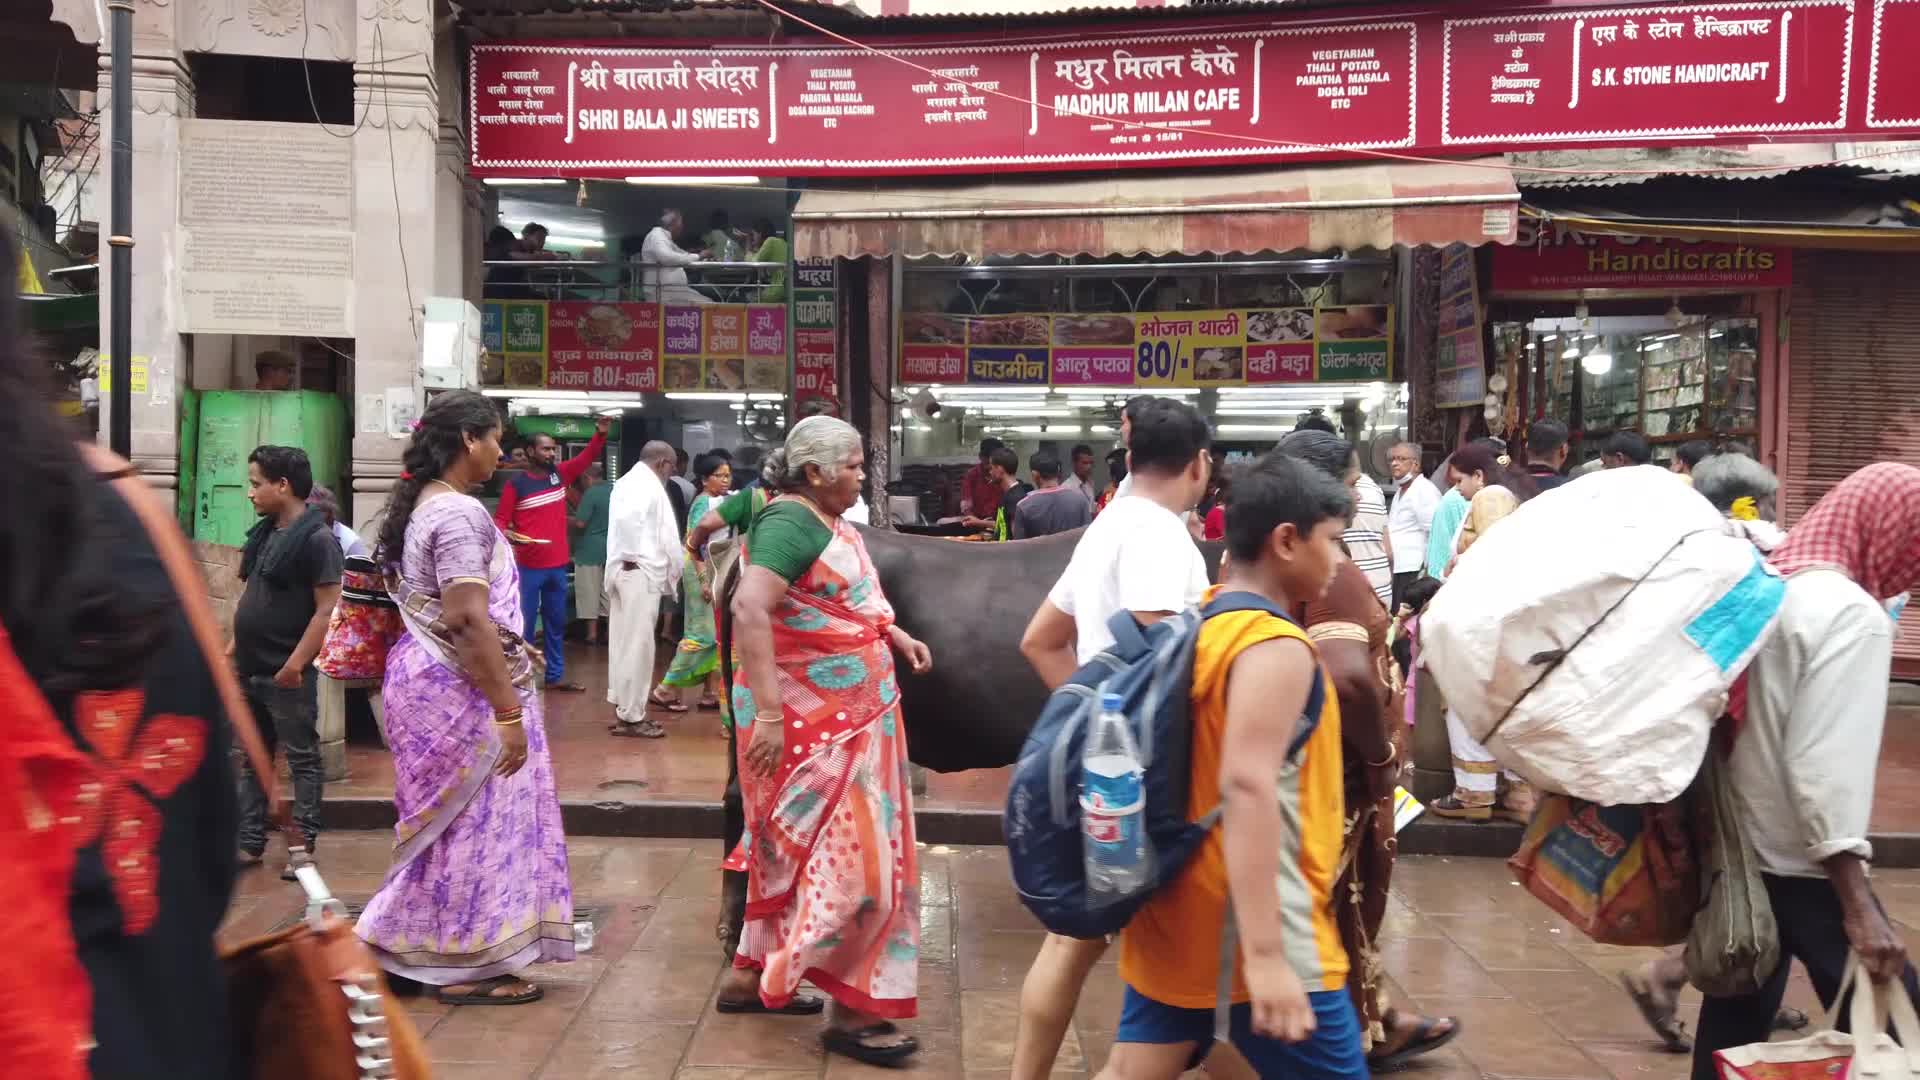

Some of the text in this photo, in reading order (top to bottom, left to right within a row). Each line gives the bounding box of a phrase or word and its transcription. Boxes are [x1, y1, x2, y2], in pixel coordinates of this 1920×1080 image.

[1592, 25, 1618, 46] एस
[1623, 19, 1640, 40] के
[1648, 18, 1684, 40] स्टोन
[1312, 48, 1375, 61] VEGETARIAN
[810, 68, 852, 78] VEGETARIAN
[1055, 59, 1109, 89] मधुर
[1113, 50, 1184, 80] मिलन
[1306, 60, 1380, 73] THALI POTATO
[1592, 61, 1769, 87] S.K. STONE HANDICRAFT
[579, 59, 760, 96] श्री बालाजी स्वीट्स
[806, 80, 856, 91] THALI POTATO
[1296, 72, 1390, 86] PARATHA MASALA
[800, 92, 863, 103] PARATHA MASALA
[1317, 85, 1368, 97] DOSA IDLI
[788, 106, 807, 116] DOSA
[1054, 88, 1240, 117] MADHUR MILAN CAFE
[1331, 98, 1351, 109] ETC
[578, 107, 760, 130] SHRI BALA JI SWEETS
[823, 118, 837, 128] ETC
[1587, 247, 1775, 272] Handicrafts
[1140, 312, 1239, 337] भोजन थाली
[1056, 356, 1131, 381] आलू पराठा
[1248, 350, 1276, 373] दही
[550, 366, 589, 385] भोजन
